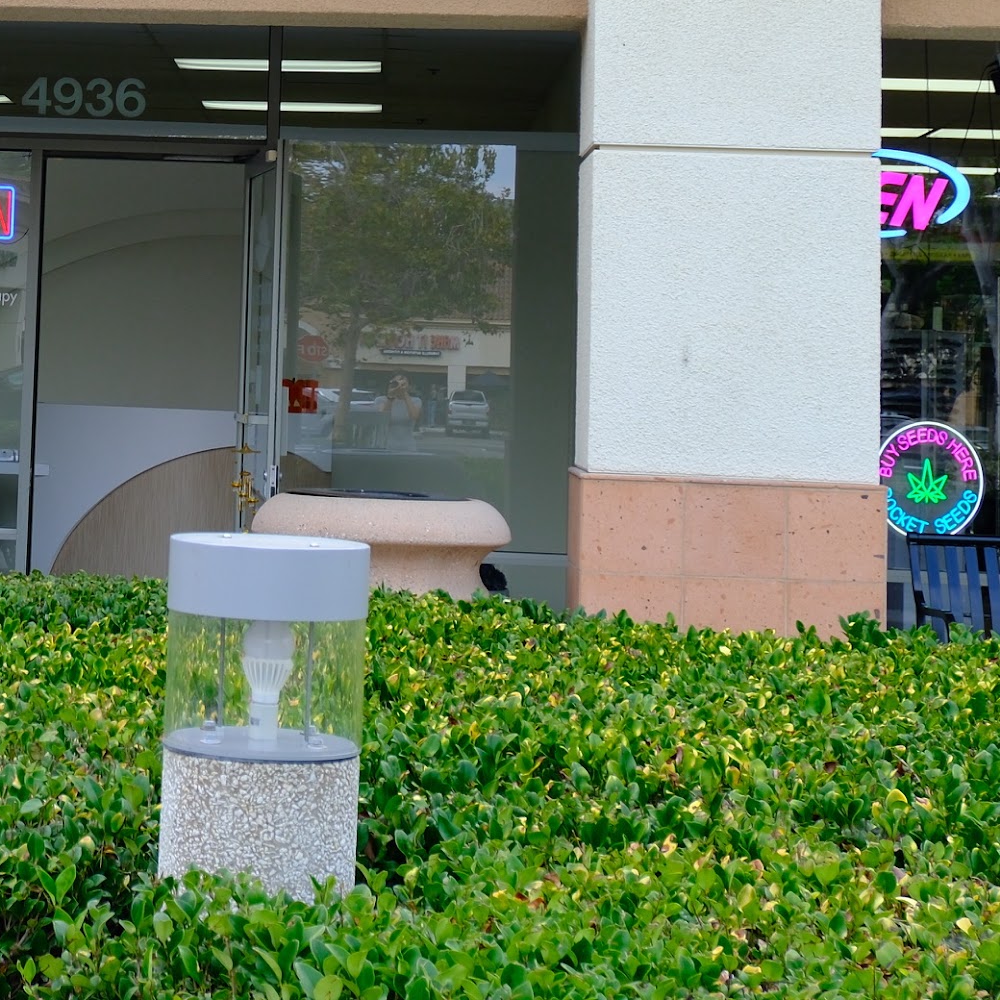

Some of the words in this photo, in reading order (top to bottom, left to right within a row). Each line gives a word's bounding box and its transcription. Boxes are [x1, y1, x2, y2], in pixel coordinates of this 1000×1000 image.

[21, 76, 147, 118] 4936
[879, 444, 900, 478] BUY
[897, 428, 948, 451] SEEDS
[946, 438, 977, 481] HERE
[934, 490, 978, 534] SEEDS
